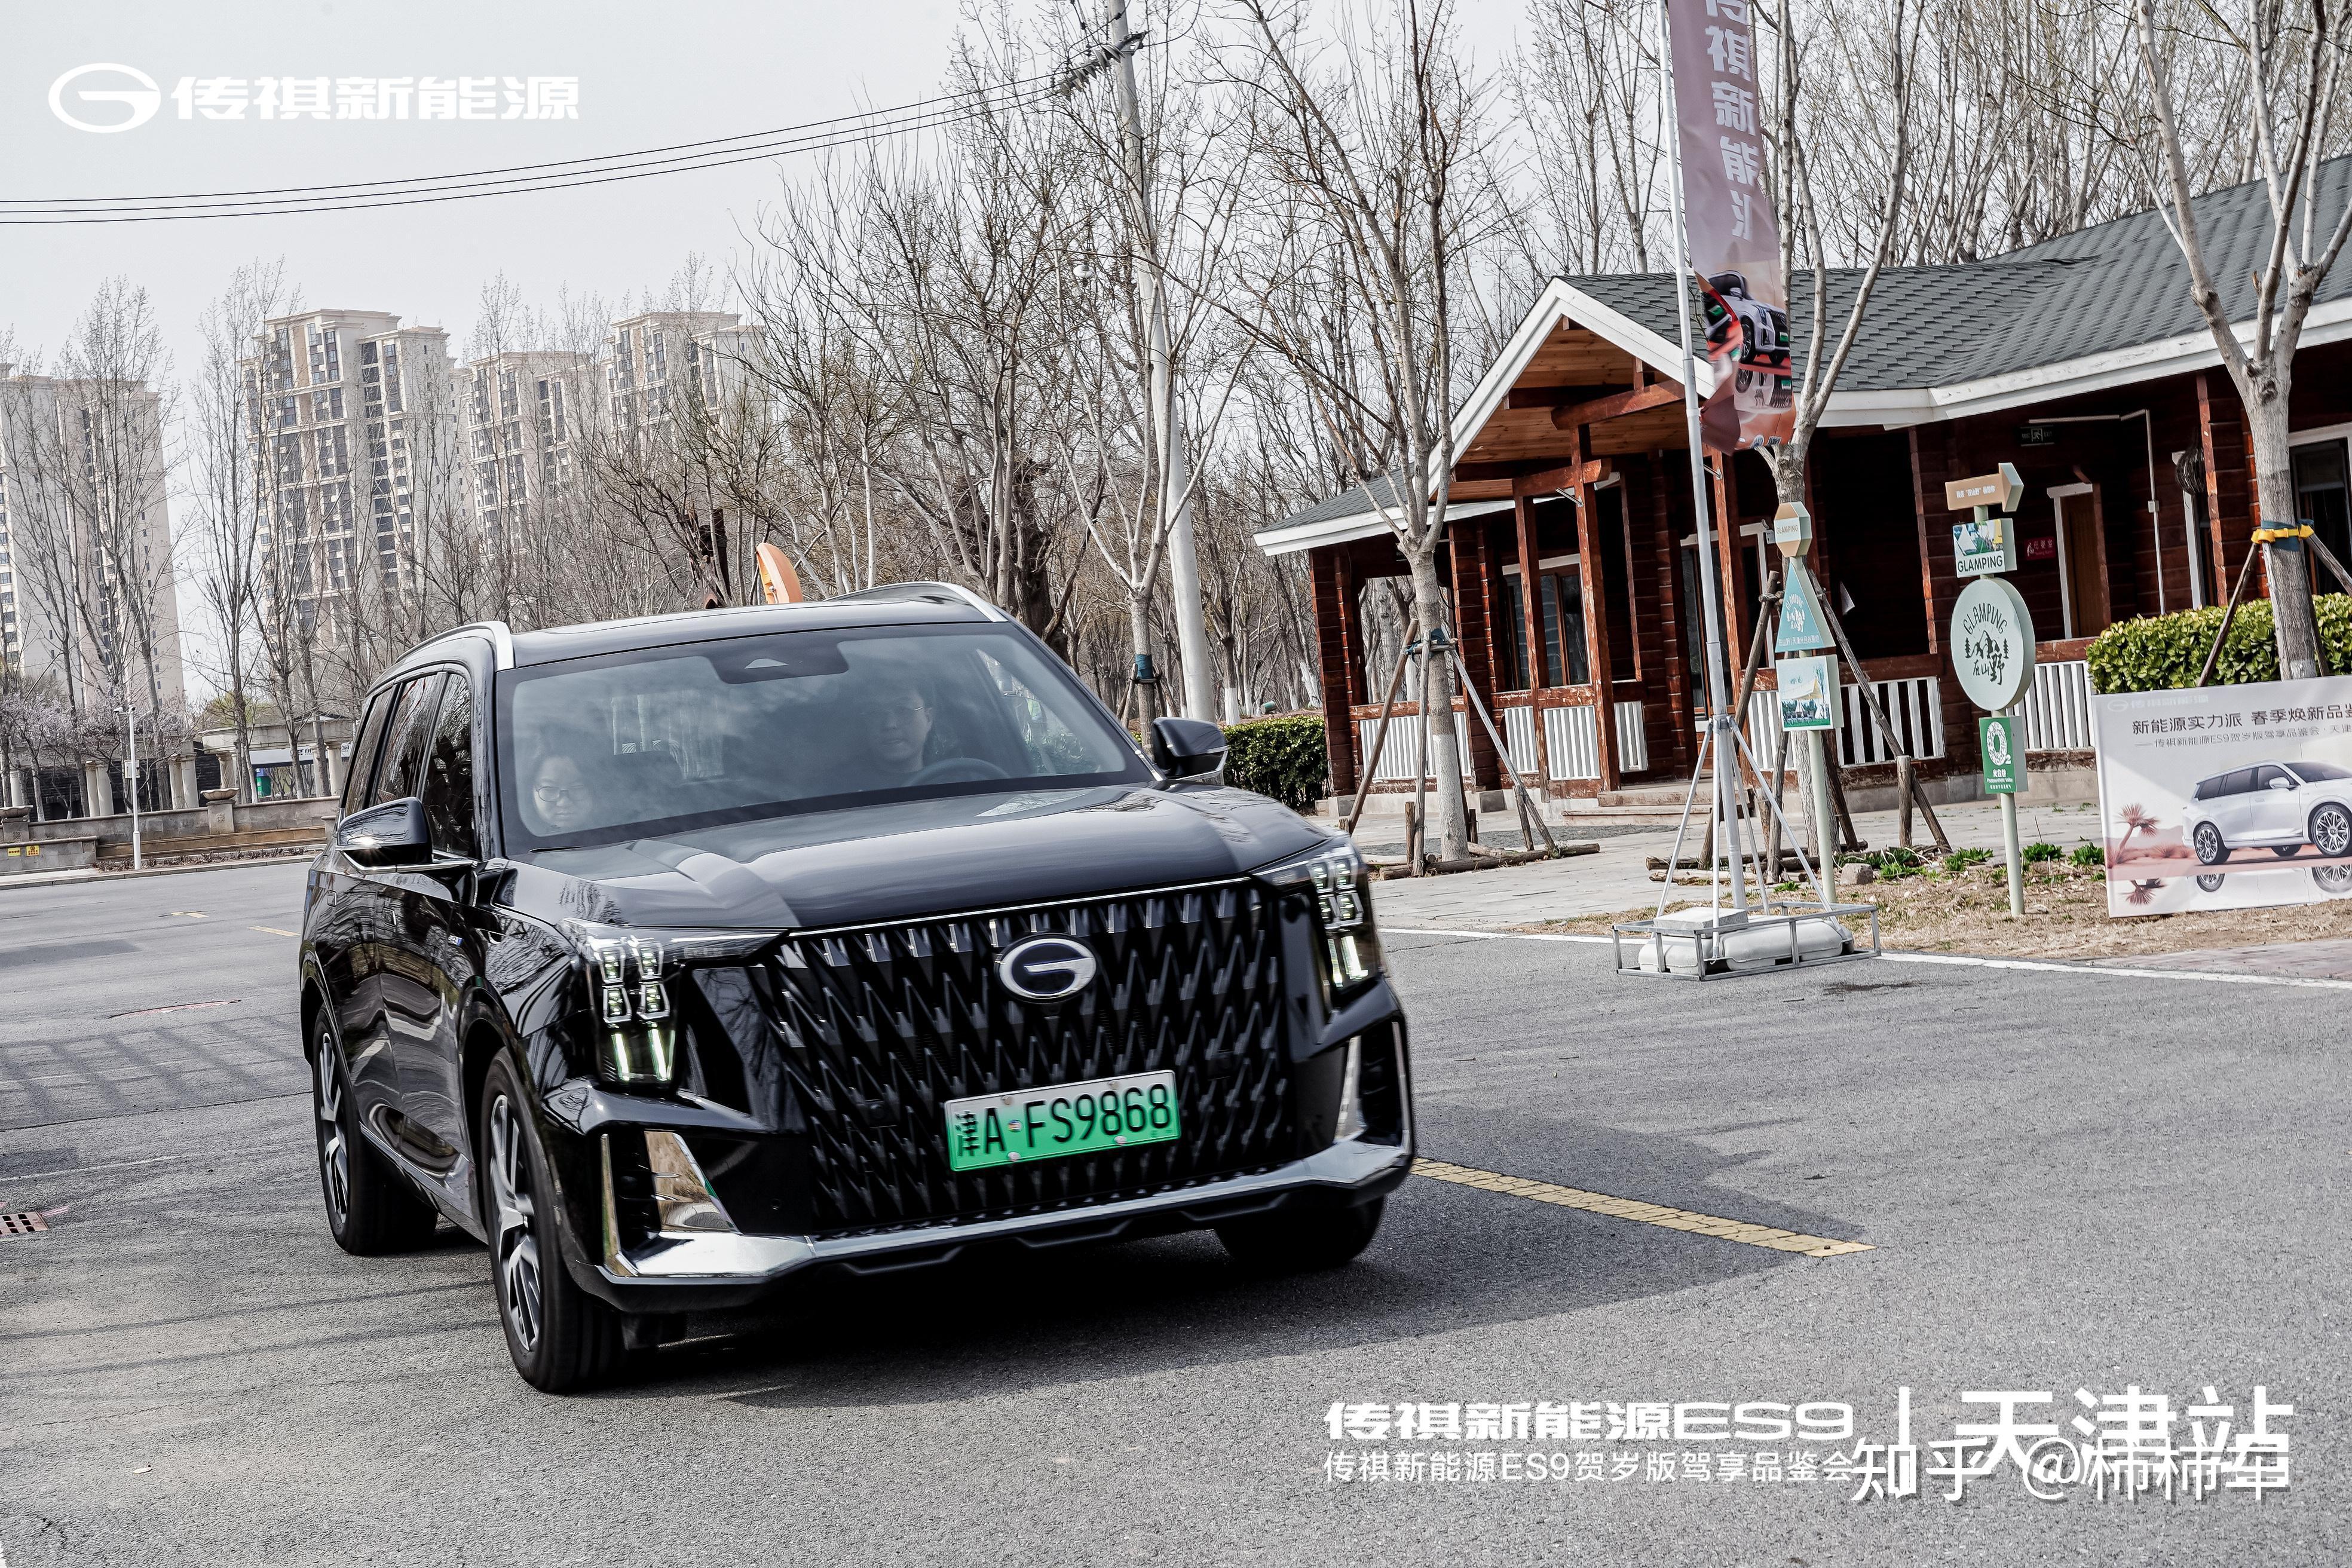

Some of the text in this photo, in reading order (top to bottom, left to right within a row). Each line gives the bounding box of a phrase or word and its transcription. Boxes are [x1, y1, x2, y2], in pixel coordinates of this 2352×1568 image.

[1776, 524, 1799, 535] GLAMPING
[1958, 555, 2003, 572] GLAMPING
[1963, 602, 2008, 635] GLAMPING
[1973, 653, 2005, 685] 在山野
[2132, 711, 2242, 735] 新能源实力派
